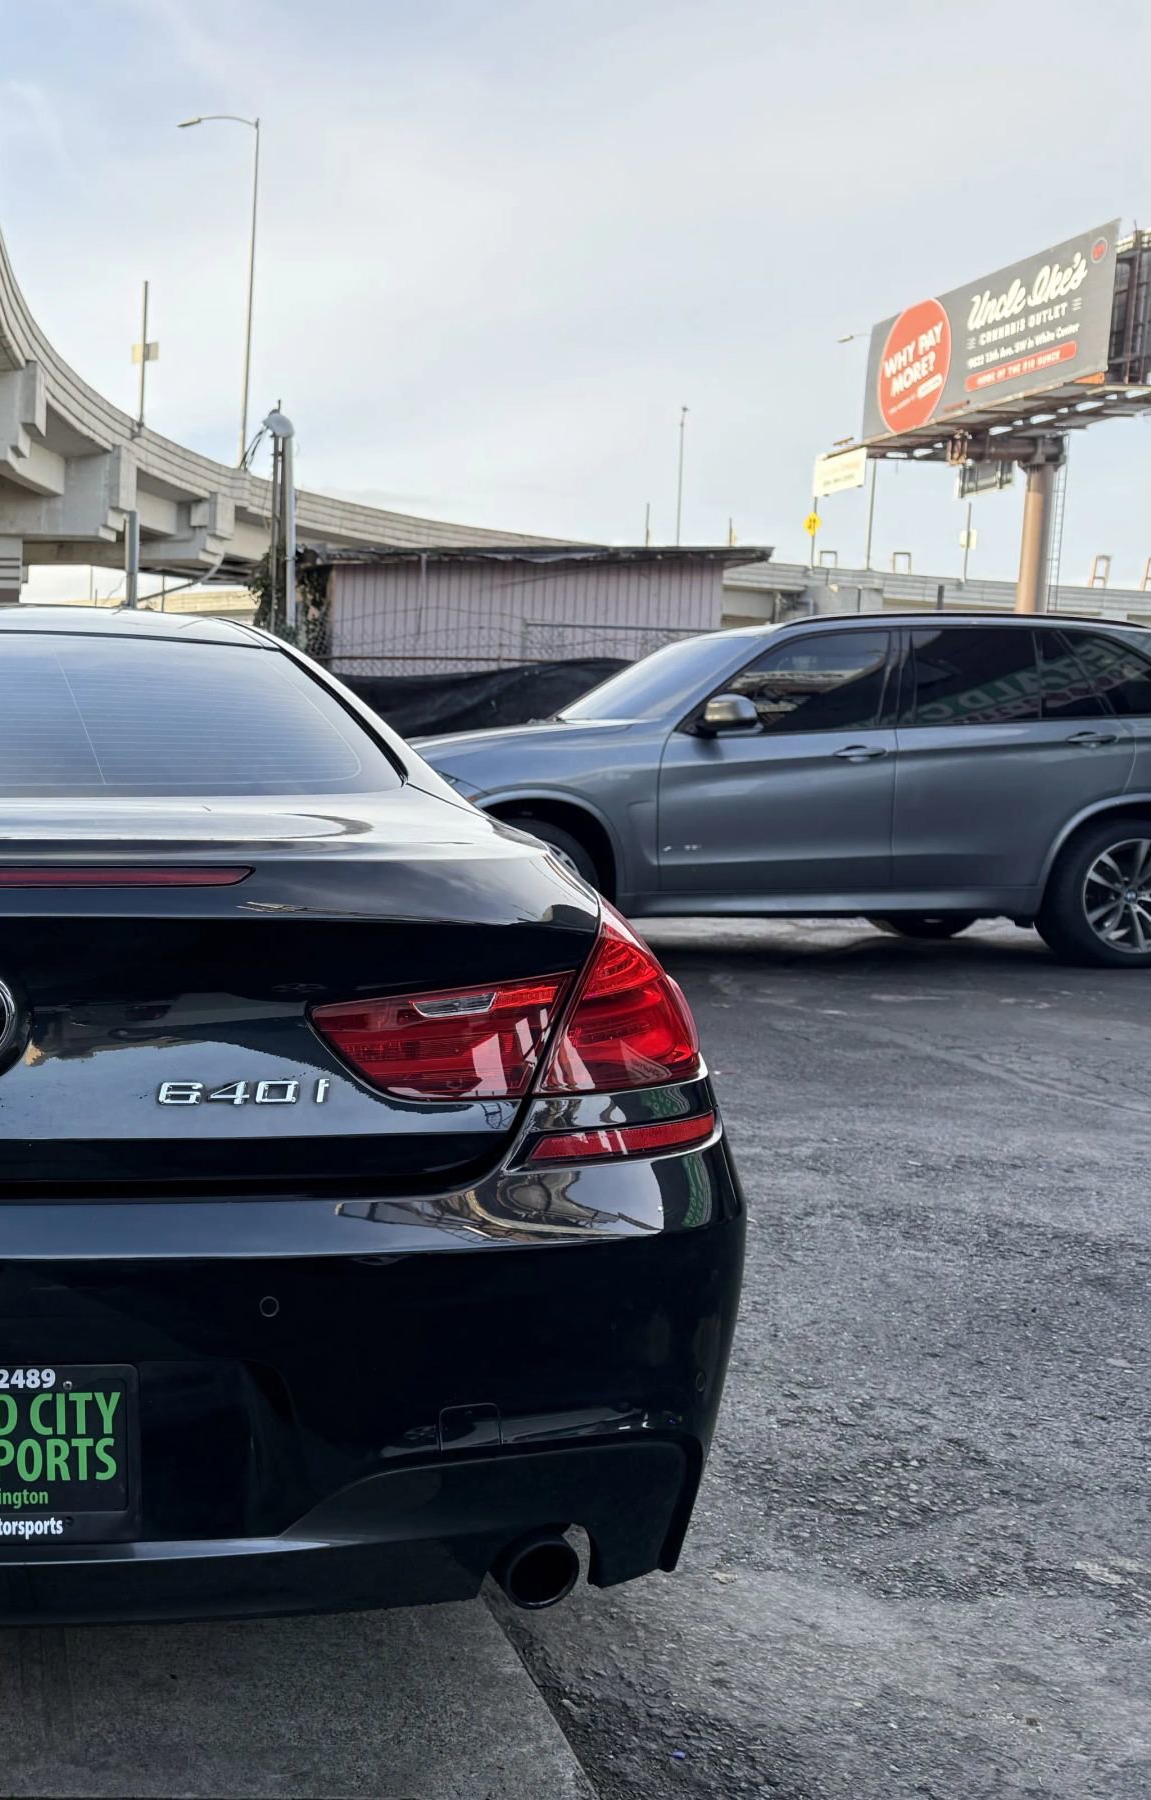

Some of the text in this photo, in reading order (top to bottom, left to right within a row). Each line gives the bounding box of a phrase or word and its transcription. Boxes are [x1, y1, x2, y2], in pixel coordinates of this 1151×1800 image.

[967, 279, 1026, 331] Uncle
[884, 321, 943, 378] WHY PAY
[891, 351, 936, 397] MORE?
[158, 1078, 329, 1105] 640i
[30, 1392, 120, 1435] CITY
